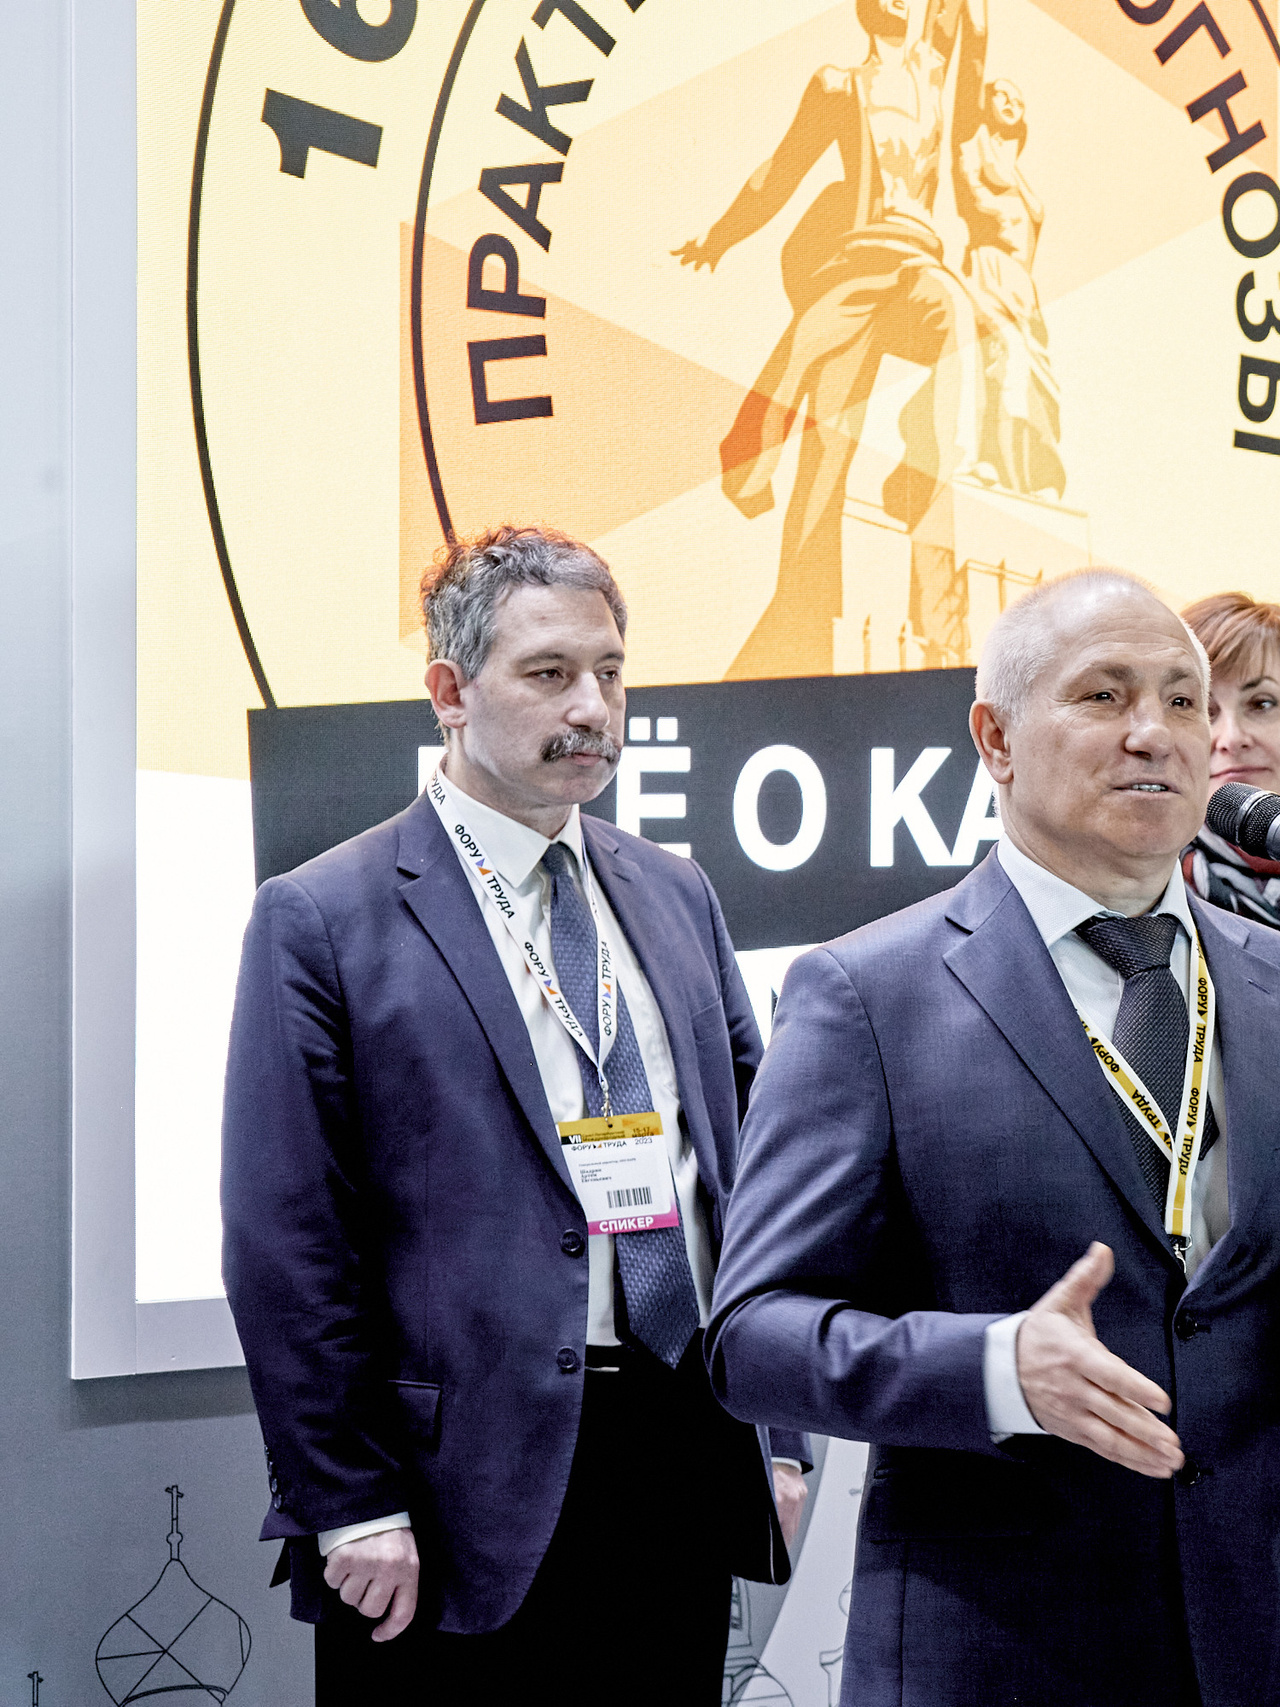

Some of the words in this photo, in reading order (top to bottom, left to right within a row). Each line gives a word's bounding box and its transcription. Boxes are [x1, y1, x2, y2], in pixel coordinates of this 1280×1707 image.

[466, 0, 646, 425] ПРАКТ
[732, 744, 828, 872] О
[486, 875, 515, 919] ТРУДА
[1193, 1024, 1206, 1063] ТРУДА
[1132, 1089, 1163, 1129] ТРУДА
[599, 1216, 654, 1233] СПИКЕР
